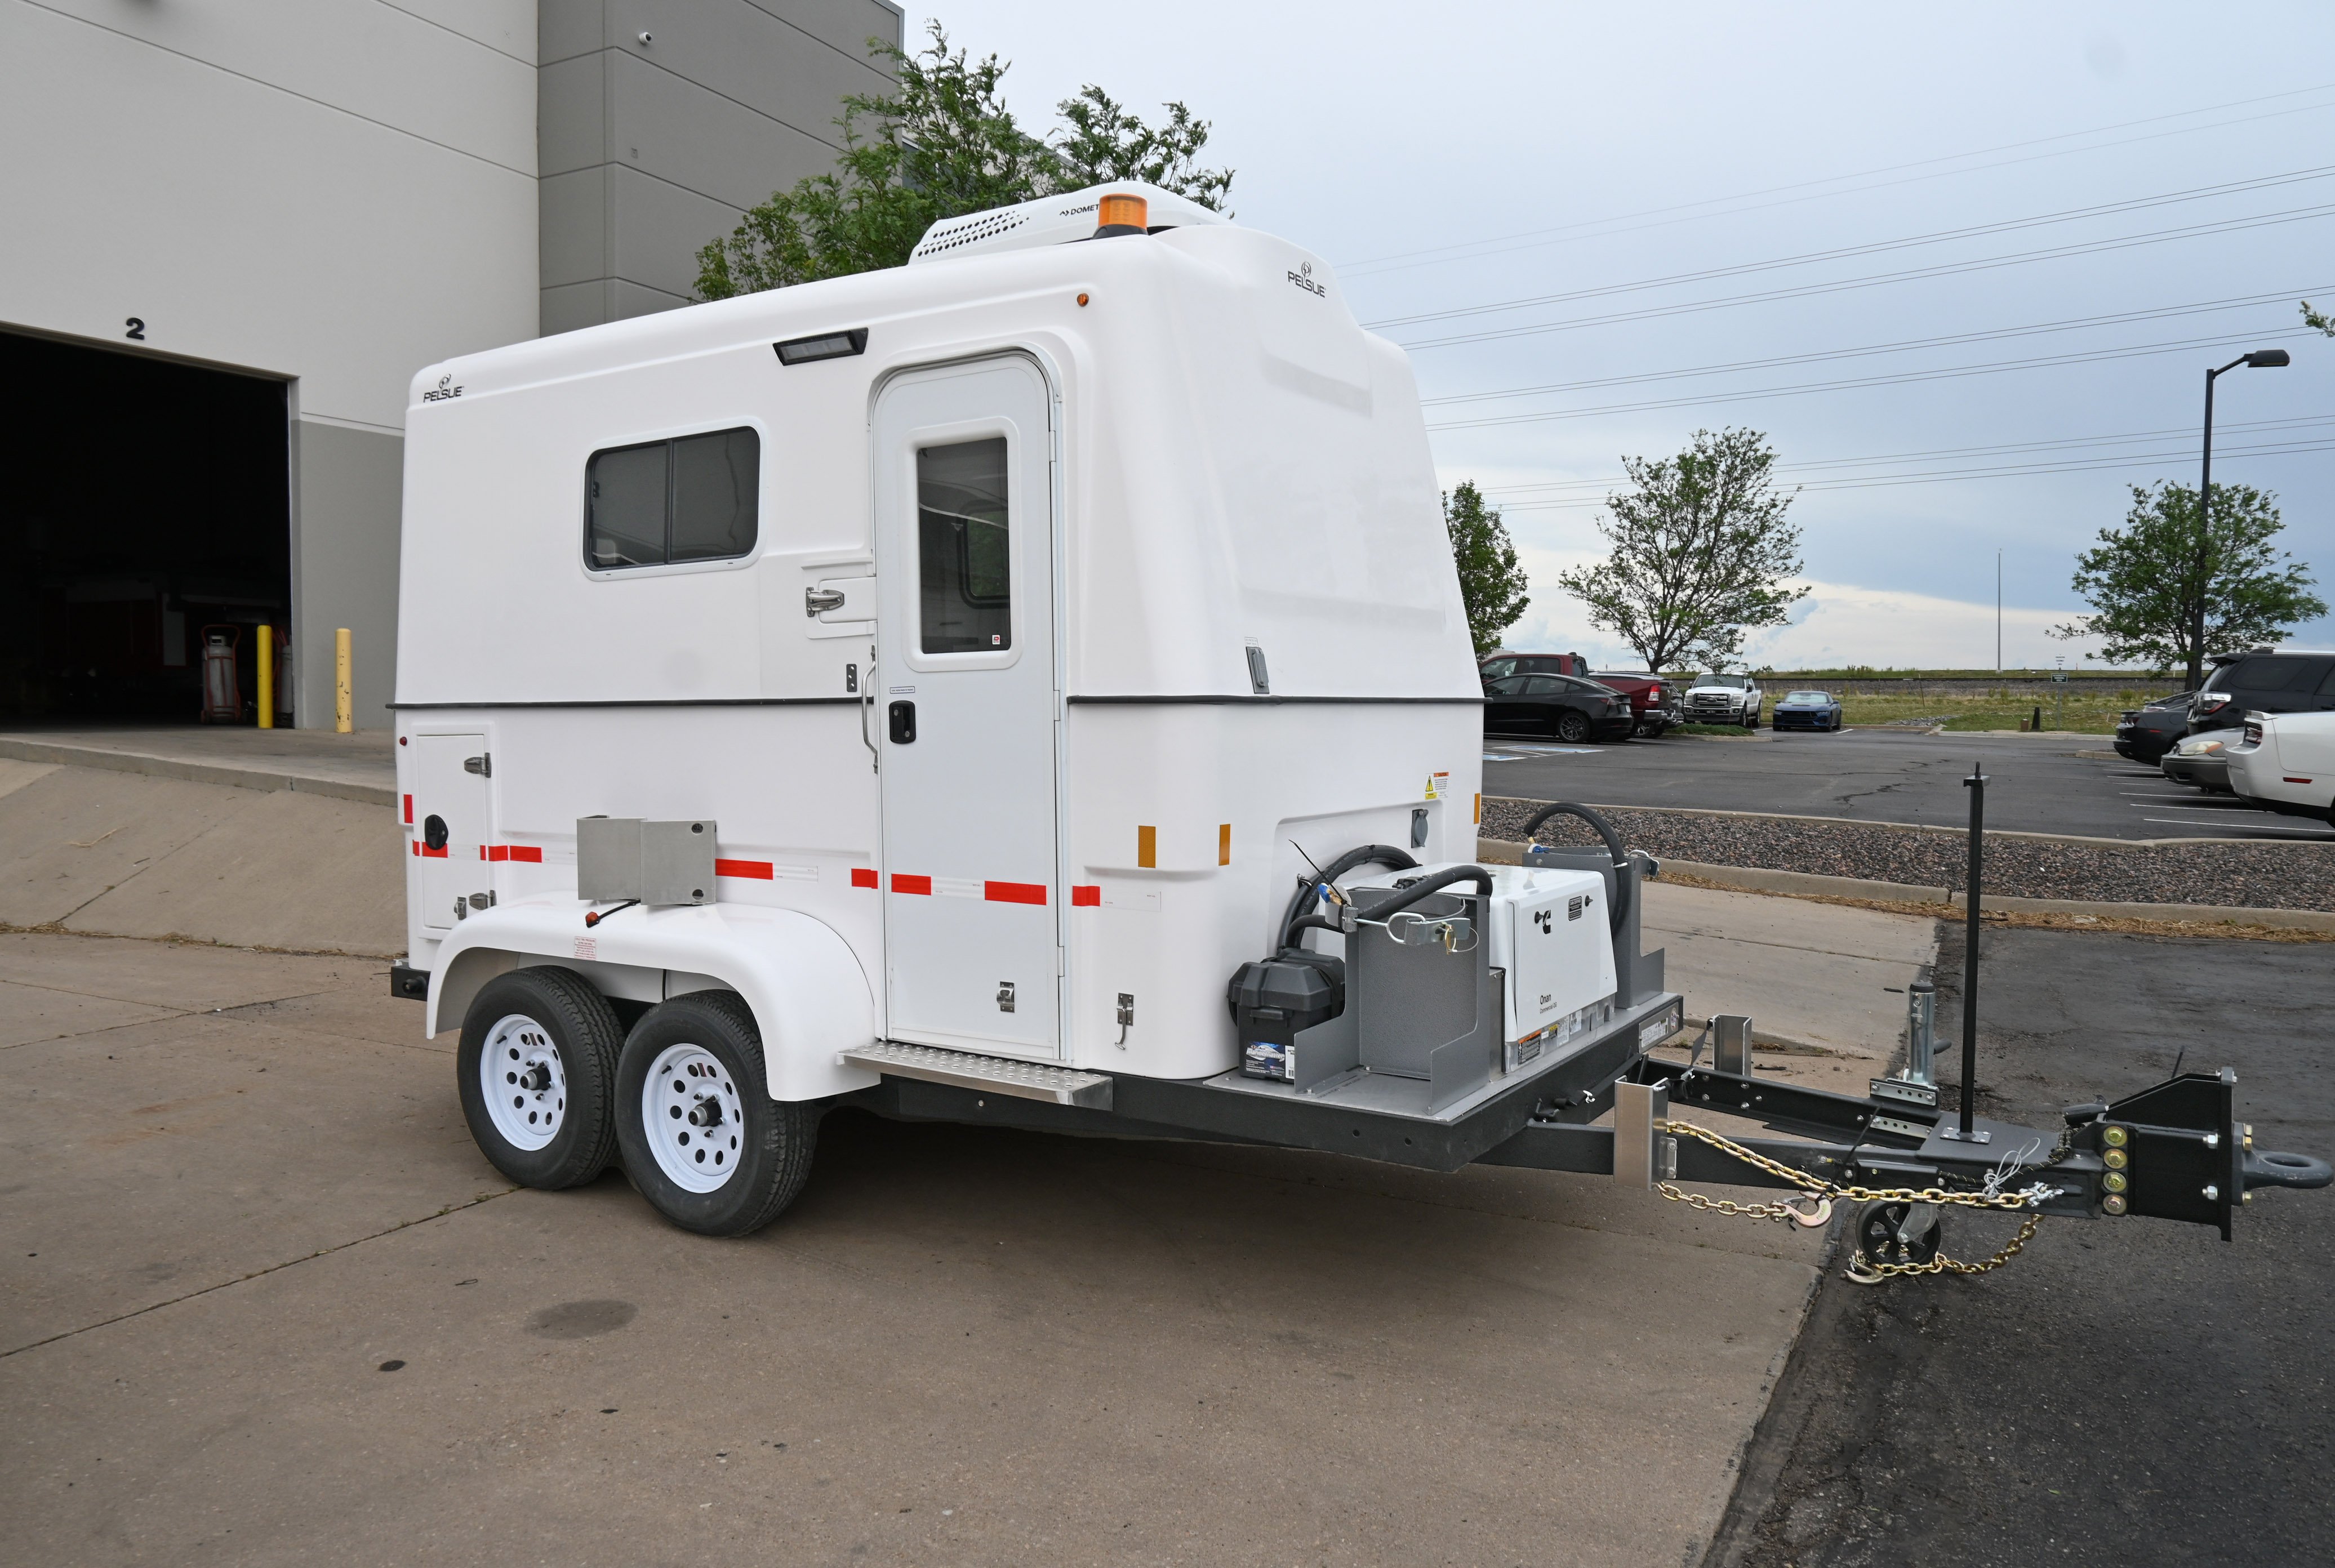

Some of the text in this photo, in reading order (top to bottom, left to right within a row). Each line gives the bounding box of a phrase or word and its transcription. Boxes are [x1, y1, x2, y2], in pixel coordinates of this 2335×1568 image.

[1070, 203, 1100, 216] DOMET
[1288, 270, 1326, 299] PELSUE
[126, 317, 145, 340] 2
[423, 386, 463, 403] PELSUE
[1540, 994, 1551, 1005] Onan
